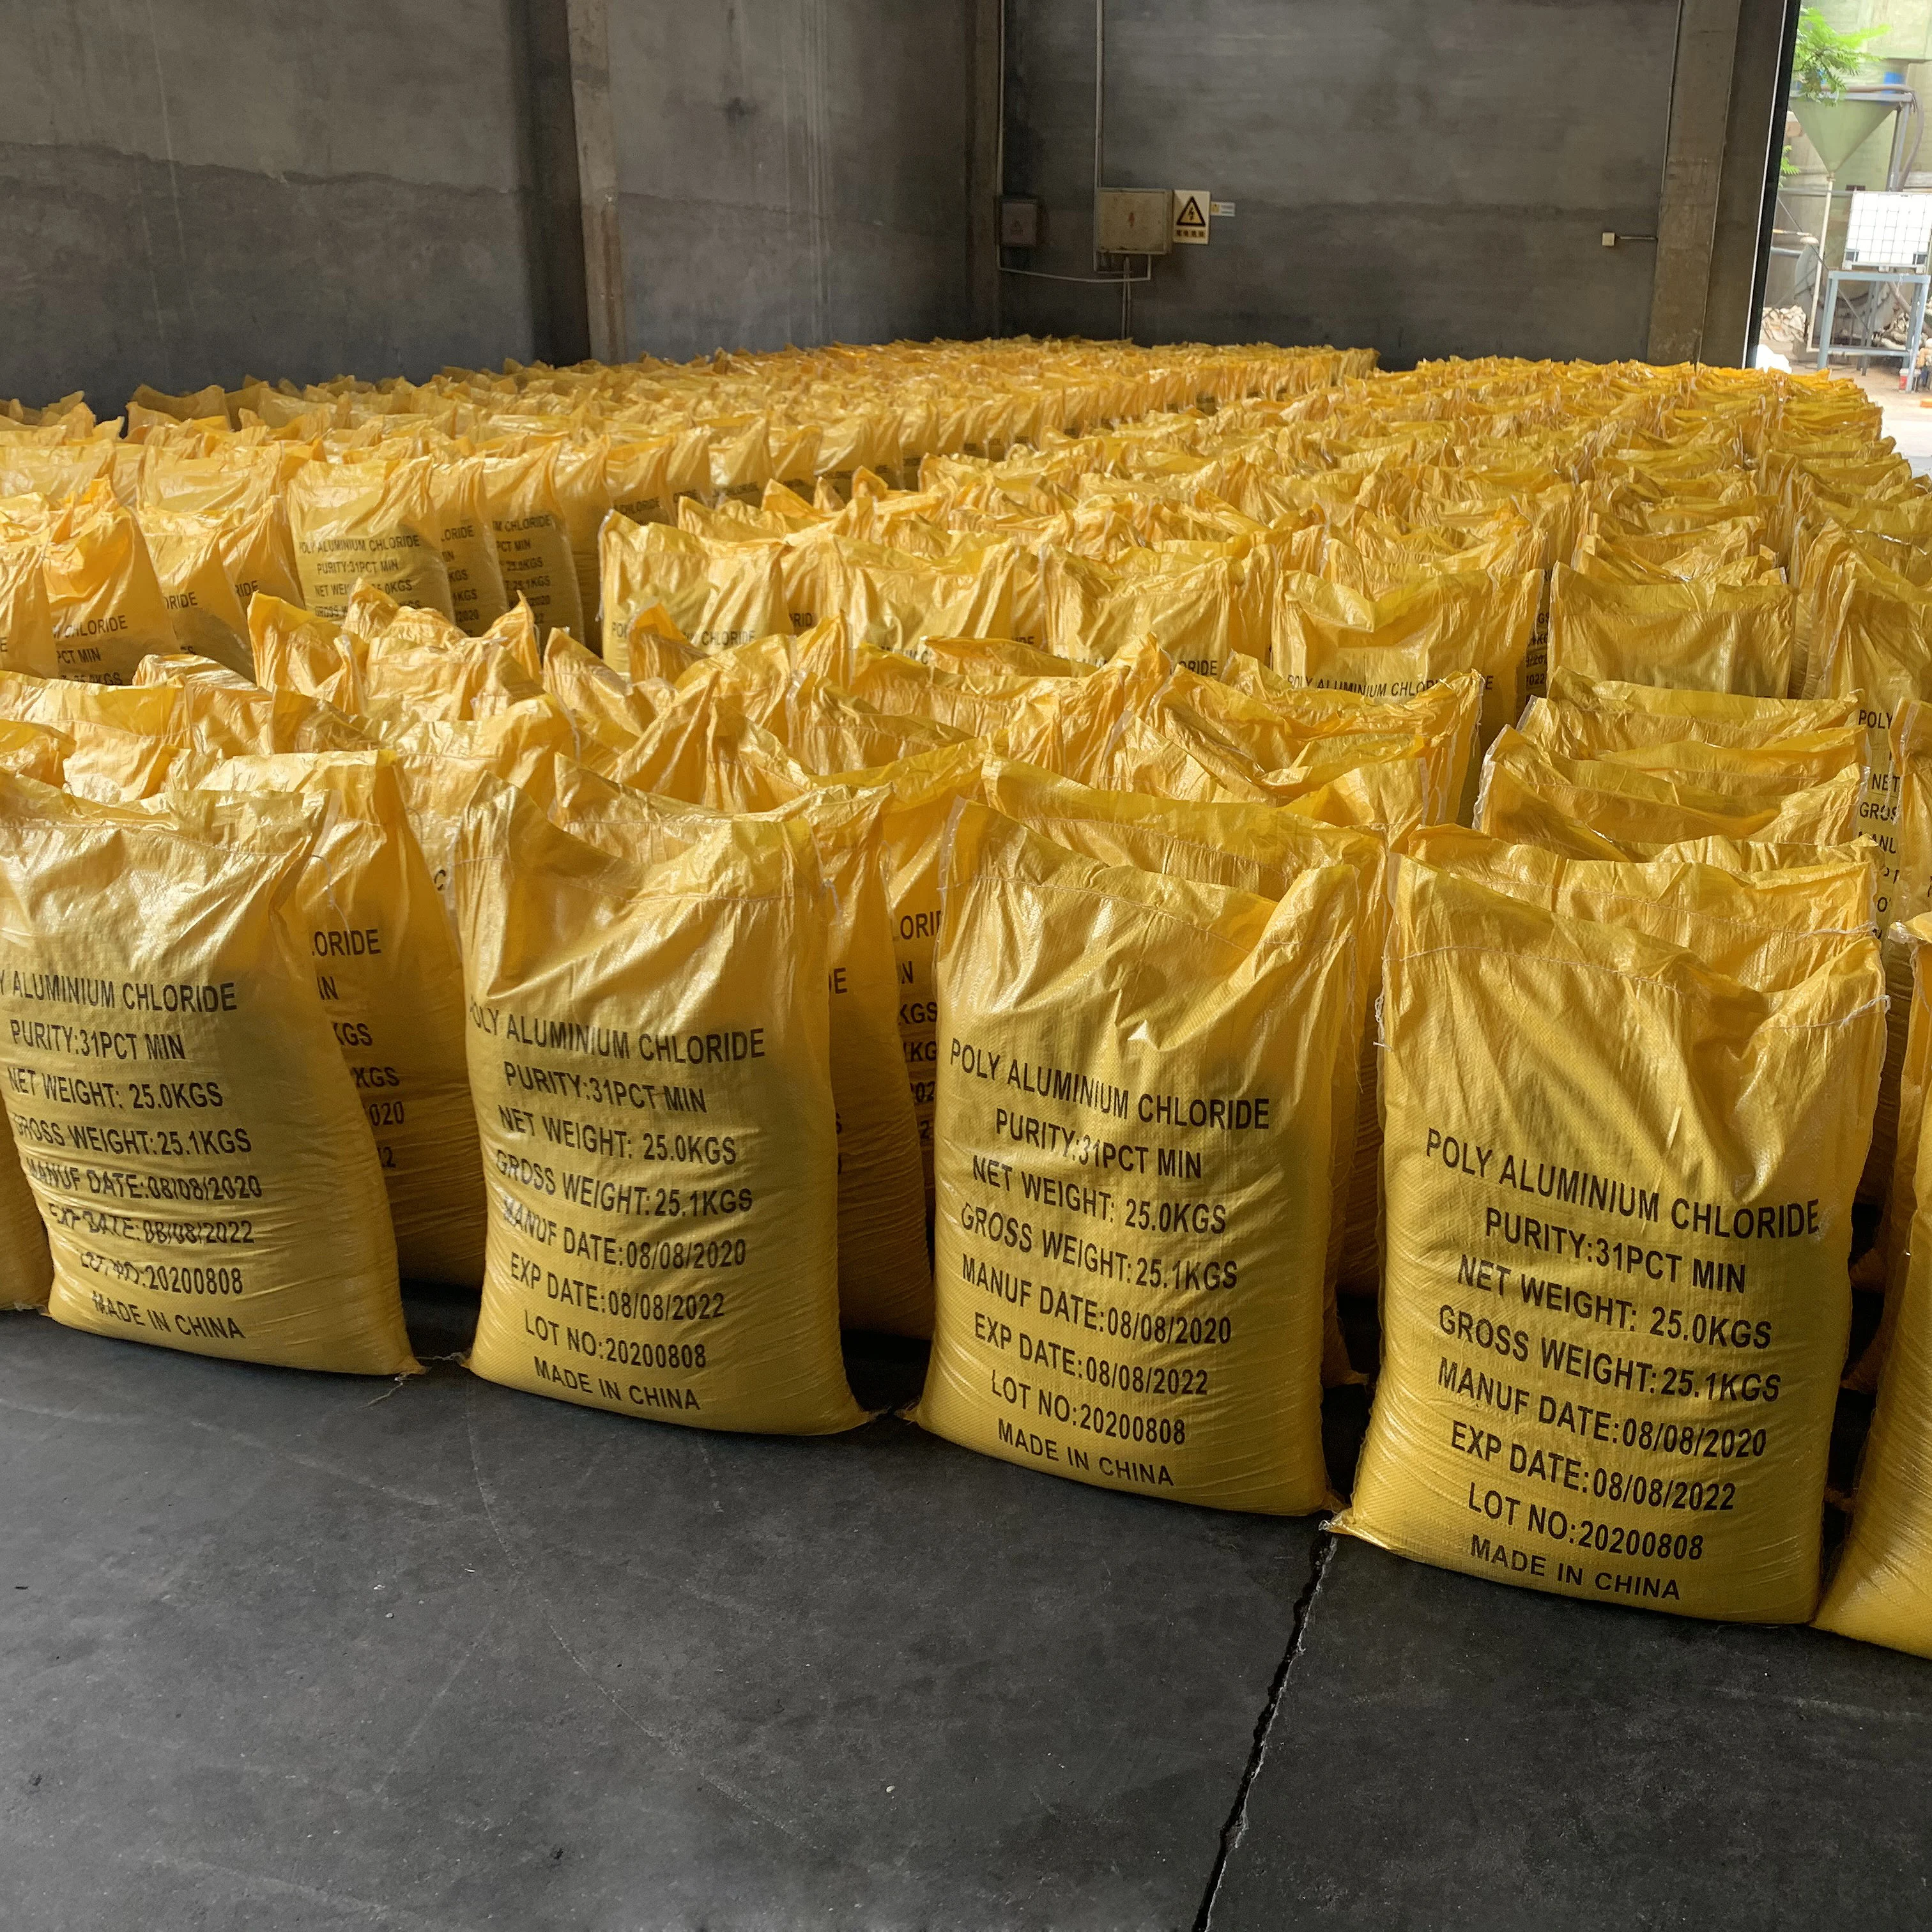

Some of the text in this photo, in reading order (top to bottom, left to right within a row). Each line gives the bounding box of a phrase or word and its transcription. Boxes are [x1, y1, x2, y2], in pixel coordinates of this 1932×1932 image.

[369, 535, 420, 552] CHLORIDE
[441, 525, 475, 542] ORIDE
[314, 585, 328, 597] NET
[381, 559, 399, 572] MIN
[77, 647, 101, 663] MIN
[312, 929, 382, 957] ORIDE
[13, 970, 114, 1009] ALUMINIUM
[123, 983, 237, 1013] CHLORIDE
[10, 1020, 186, 1060] PURITY:31PCT MIN
[507, 1014, 629, 1059] ALUMINIUM
[639, 1029, 765, 1064] CHLORIDE
[8, 1067, 224, 1109] NET WEIGHT: 25.0KGS
[504, 1061, 706, 1113] PURITY:31PCT MIN
[950, 1038, 999, 1081] POLY
[1008, 1059, 1129, 1120] ALUMINIUM
[1138, 1093, 1269, 1129] CHLORIDE
[68, 1126, 251, 1155] WEIGHT:25.1KGS
[498, 1105, 737, 1165] NET WEIGHT: 25.0KGS
[995, 1108, 1201, 1179] PURITY:31PCT MIN
[86, 1170, 262, 1200] DATE:08/08/2020
[496, 1150, 753, 1217] GROSS WEIGHT:25.1KGS
[972, 1156, 1226, 1234] NET WEIGHT: 25.0KGS
[1427, 1128, 1820, 1239] POLY ALUMINIUM CHLORIDE
[564, 1227, 746, 1269] DATE:08/08/2020
[961, 1202, 1238, 1291] GROSS WEIGHT:25.1KGS
[1485, 1207, 1745, 1292] PURITY:31PCT MIN
[92, 1291, 246, 1340] MADE IN CHINA
[510, 1253, 724, 1321] EXP DATE:08/08/2022
[962, 1254, 1231, 1344] MANUF DATE:08/08/2020
[1457, 1254, 1772, 1349] NET WEIGHT: 25.0KGS
[525, 1312, 706, 1368] LOT NO:20200808
[975, 1313, 1208, 1395] EXP DATE:08/08/2022
[1439, 1305, 1781, 1402] GROSS WEIGHT:25.1KGS
[534, 1357, 700, 1411] MADE IN CHINA
[992, 1370, 1186, 1445] LOT NO:20200808
[1438, 1356, 1766, 1458] MANUF DATE:08/08/2020
[998, 1418, 1174, 1487] MADE IN CHINA
[1452, 1420, 1736, 1512] EXP DATE:08/08/2022
[1469, 1482, 1704, 1560] LOT NO:20200808
[1471, 1535, 1681, 1600] MADE IN CHINA
